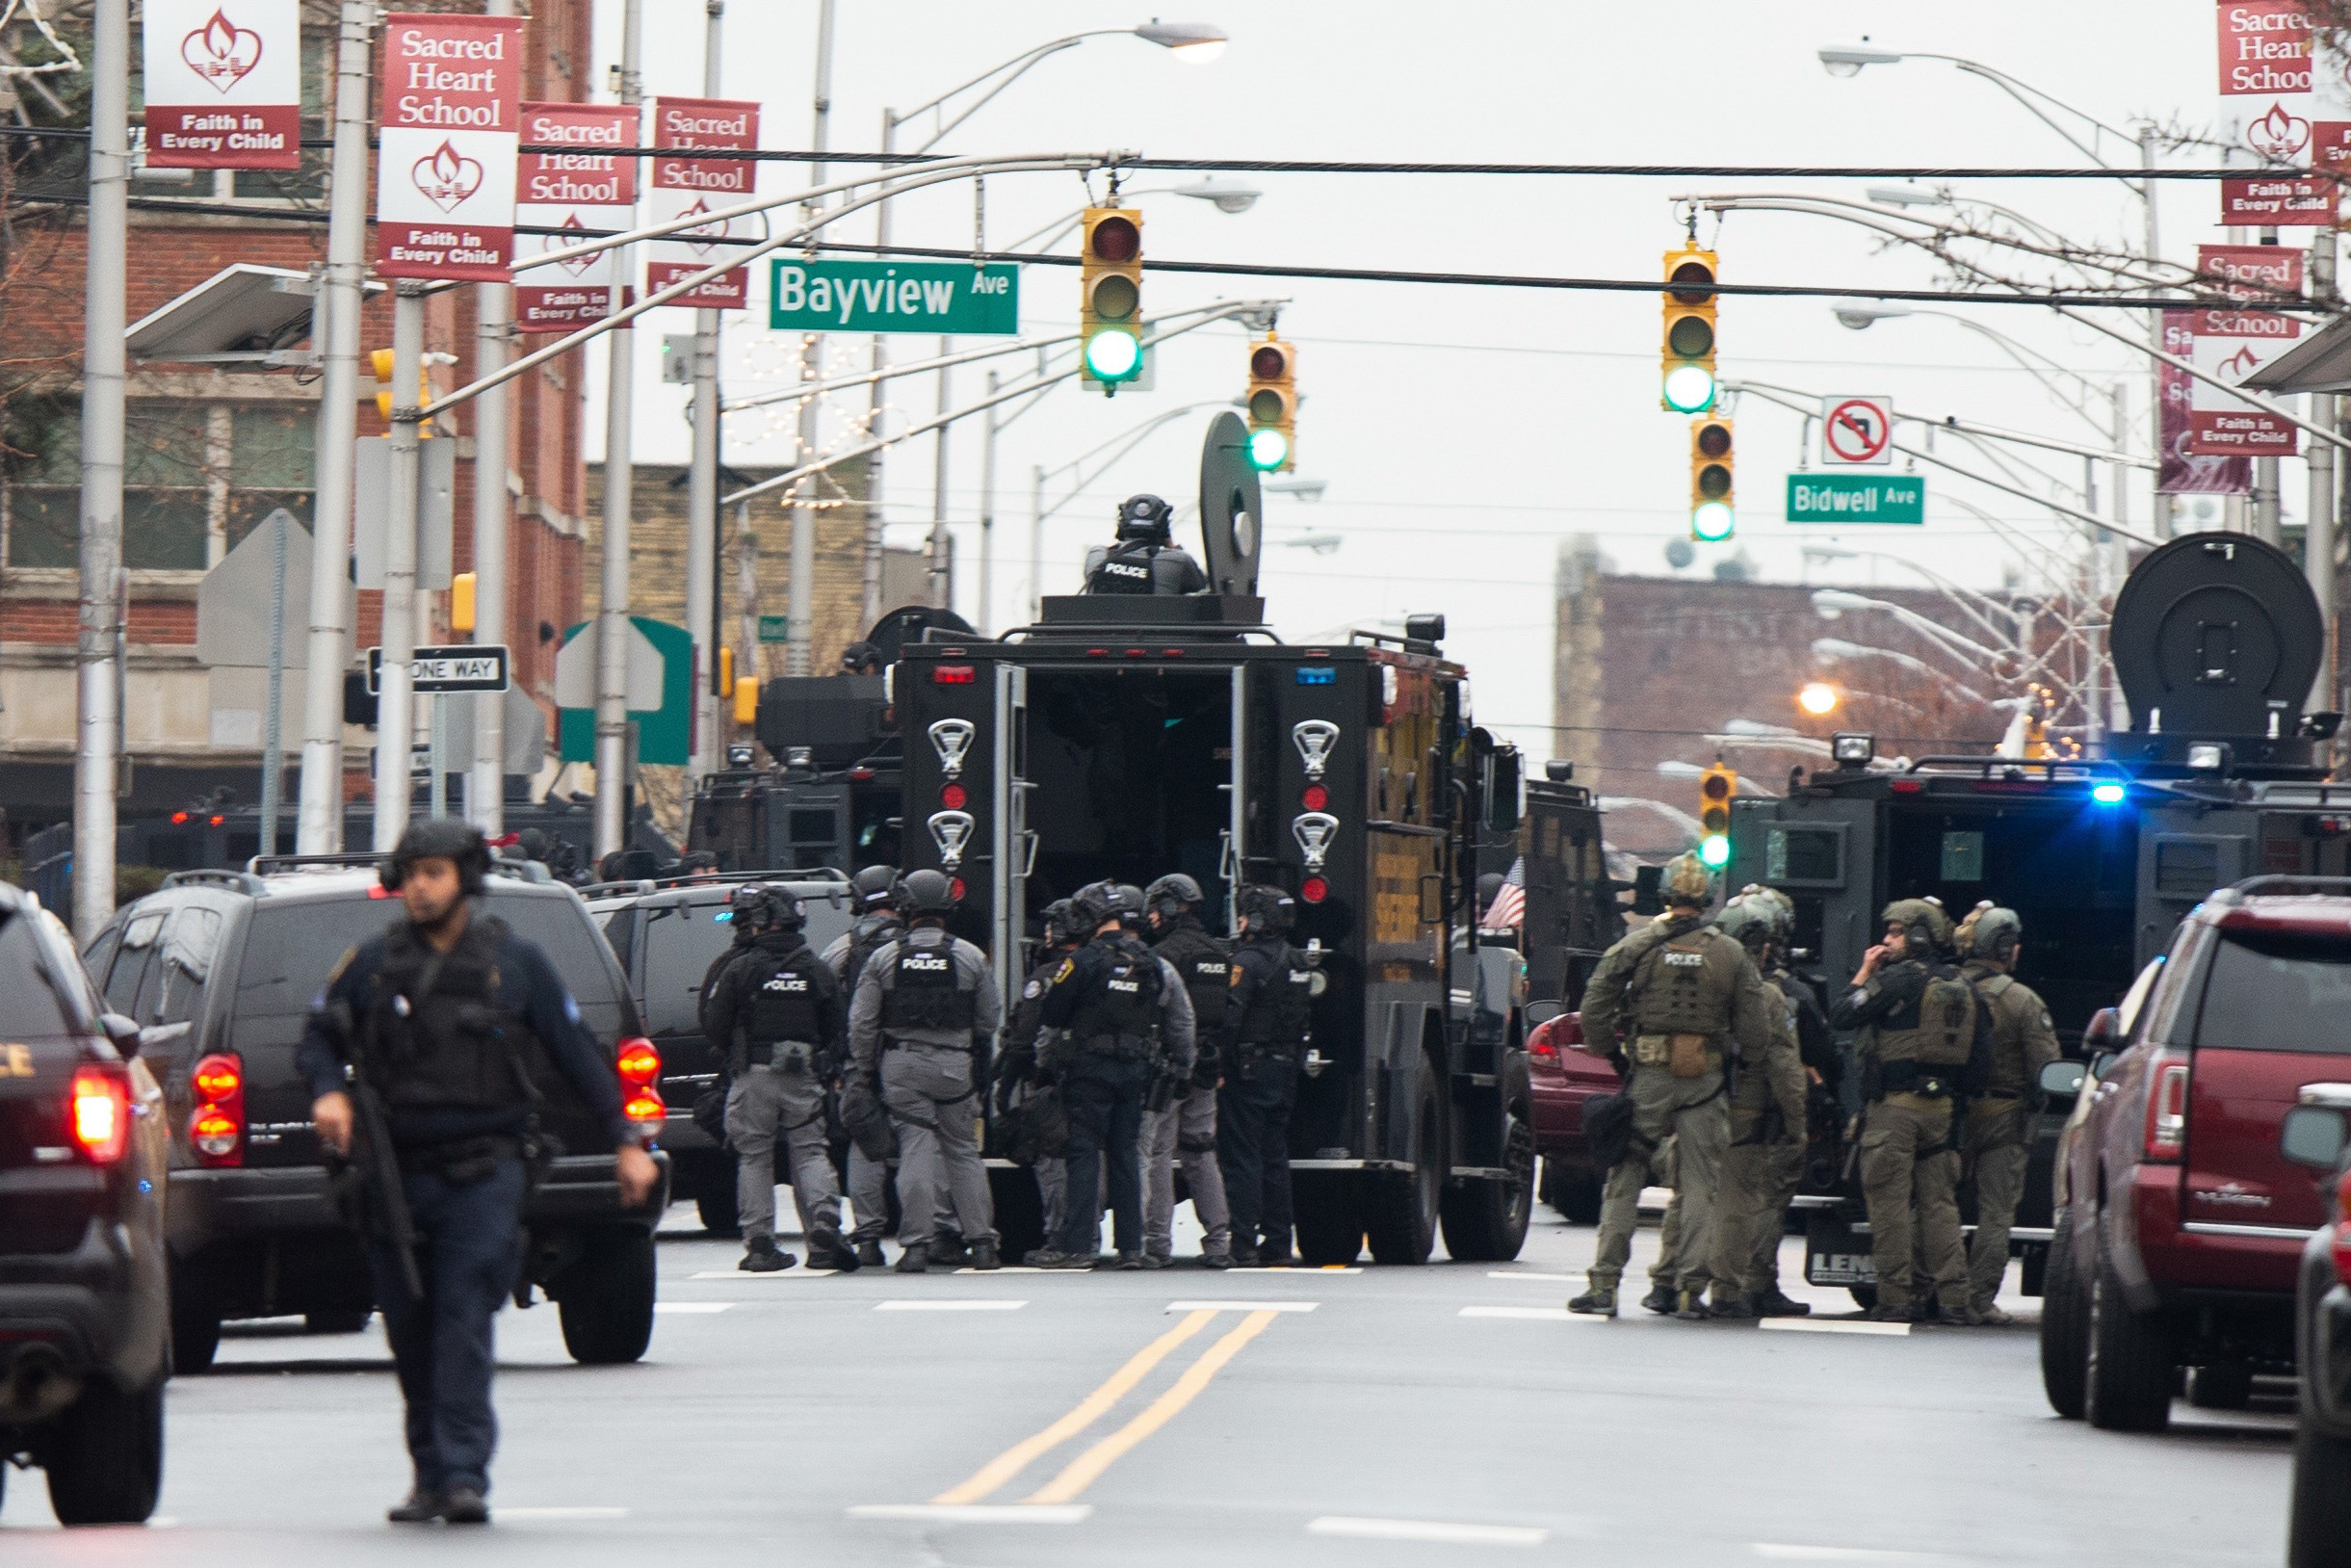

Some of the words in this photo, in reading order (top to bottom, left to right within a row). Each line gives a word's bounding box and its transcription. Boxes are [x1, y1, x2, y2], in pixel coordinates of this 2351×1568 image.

[402, 30, 505, 61] Sacred
[2238, 36, 2312, 61] Hear
[406, 63, 497, 93] Heart
[2232, 64, 2312, 91] Schoo
[398, 96, 502, 127] School
[181, 115, 237, 131] Faith
[242, 115, 264, 131] in
[532, 118, 622, 144] Sacred
[666, 110, 746, 136] Sacred
[161, 133, 222, 153] Every
[228, 133, 284, 150] Child
[664, 163, 744, 189] School
[531, 175, 619, 201] School
[2248, 184, 2291, 196] Faith
[2295, 183, 2312, 196] in
[2232, 198, 2281, 214] Every
[408, 230, 458, 247] Faith
[461, 232, 482, 248] in
[390, 247, 446, 265] Every
[449, 248, 499, 266] Child
[2208, 257, 2290, 282] Sacred
[543, 293, 587, 305] Faith
[591, 293, 607, 303] in
[779, 265, 954, 325] Bayview
[971, 271, 1009, 295] Ave
[528, 306, 576, 320] Every
[2216, 418, 2254, 430] Faith
[2259, 418, 2273, 430] in
[2202, 431, 2244, 444] Every
[2248, 431, 2287, 443] Child
[1794, 484, 1877, 512] Bidwell
[1885, 487, 1916, 504] Ave
[1105, 562, 1148, 579] POLICE
[412, 662, 446, 678] ONE
[454, 661, 492, 677] WAY
[902, 958, 948, 971] POLICE
[1196, 962, 1227, 974] POLICE
[1813, 1253, 1875, 1272] LEN
